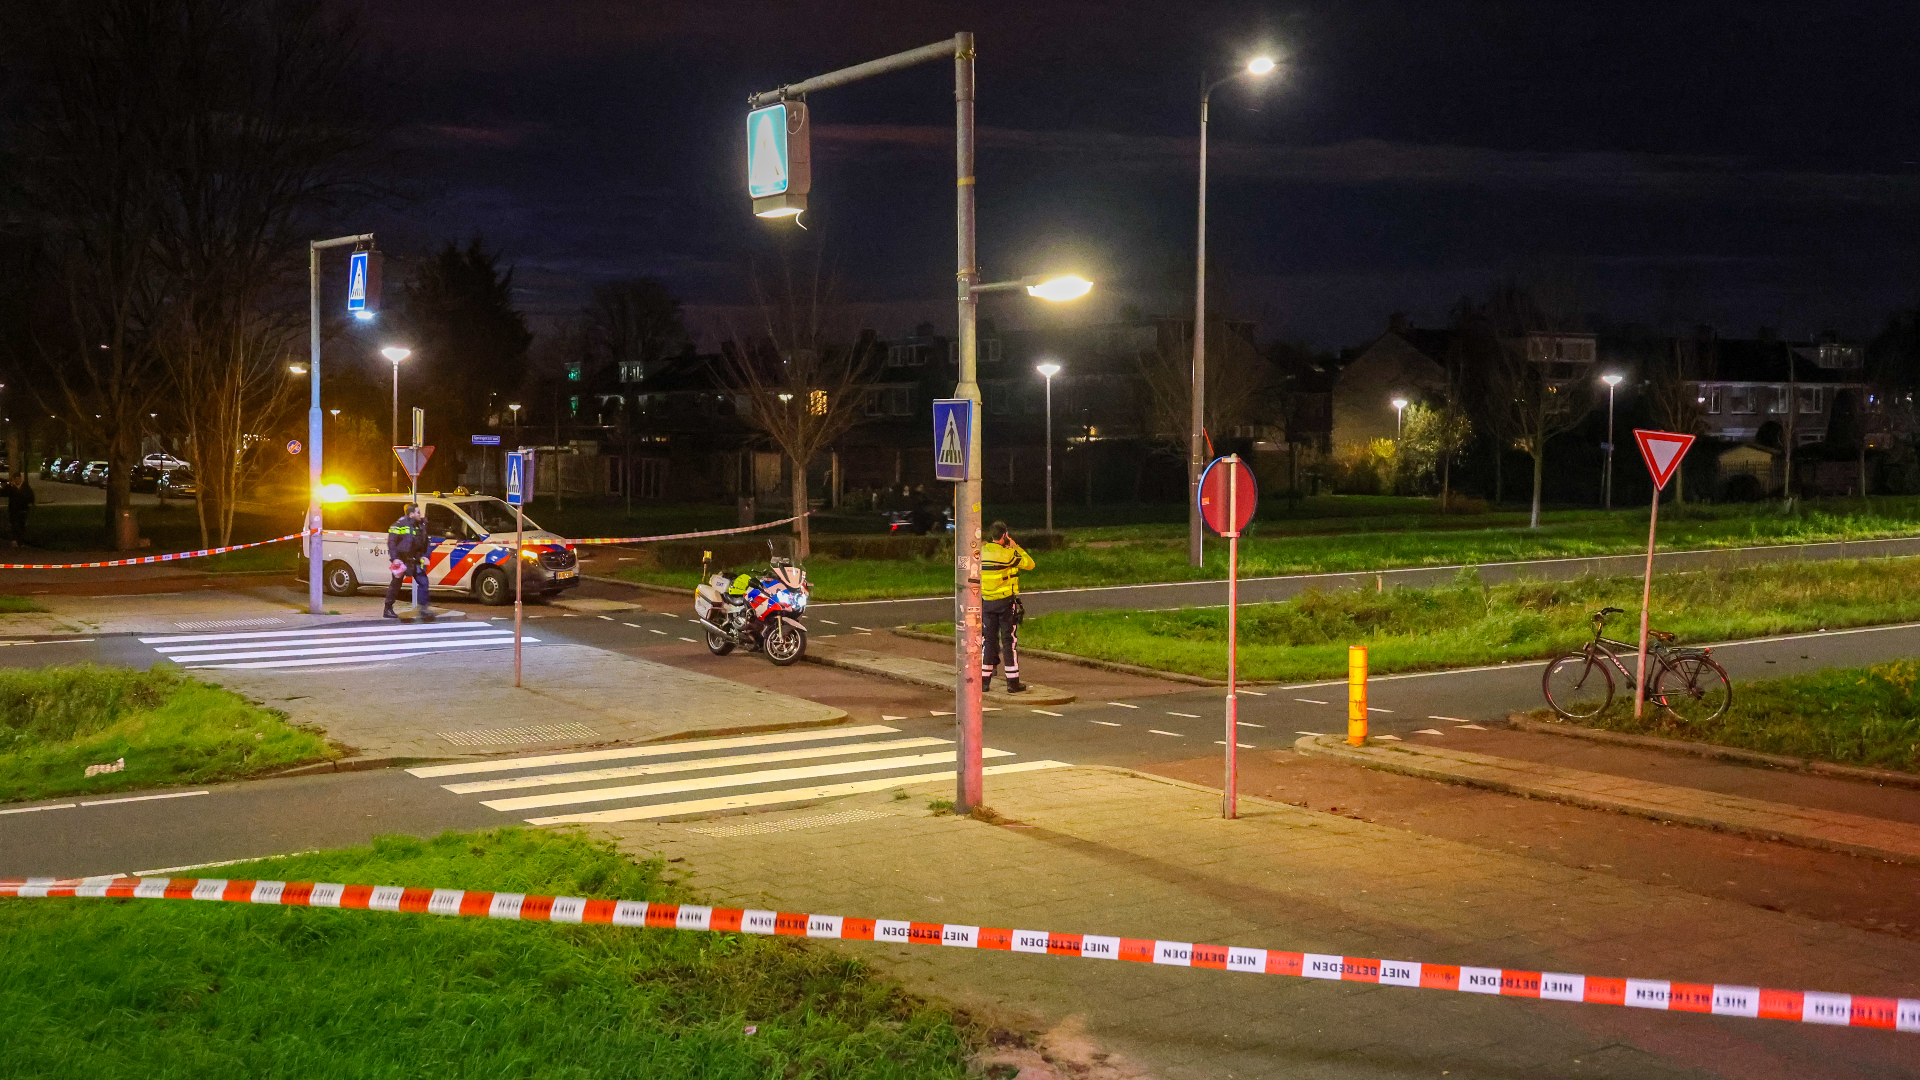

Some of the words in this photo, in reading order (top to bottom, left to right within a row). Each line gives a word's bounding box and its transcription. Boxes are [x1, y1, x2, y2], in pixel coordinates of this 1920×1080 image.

[311, 889, 335, 898] NIET
[431, 894, 454, 905] NIET
[679, 911, 702, 923] NIET
[750, 915, 806, 930] BETREDEN
[808, 920, 833, 932] NIET
[882, 926, 940, 940] BETREDEN
[943, 930, 969, 942] NIET
[1020, 936, 1080, 951] BETREDEN
[1083, 942, 1110, 953] NIET
[1163, 948, 1226, 963] BETREDEN
[1228, 954, 1256, 966] NIET
[1312, 961, 1378, 977] BETREDEN
[1381, 967, 1410, 979] NIET
[1469, 974, 1539, 990] BETREDEN
[1543, 981, 1573, 993] NIET
[1715, 996, 1747, 1009] NIET
